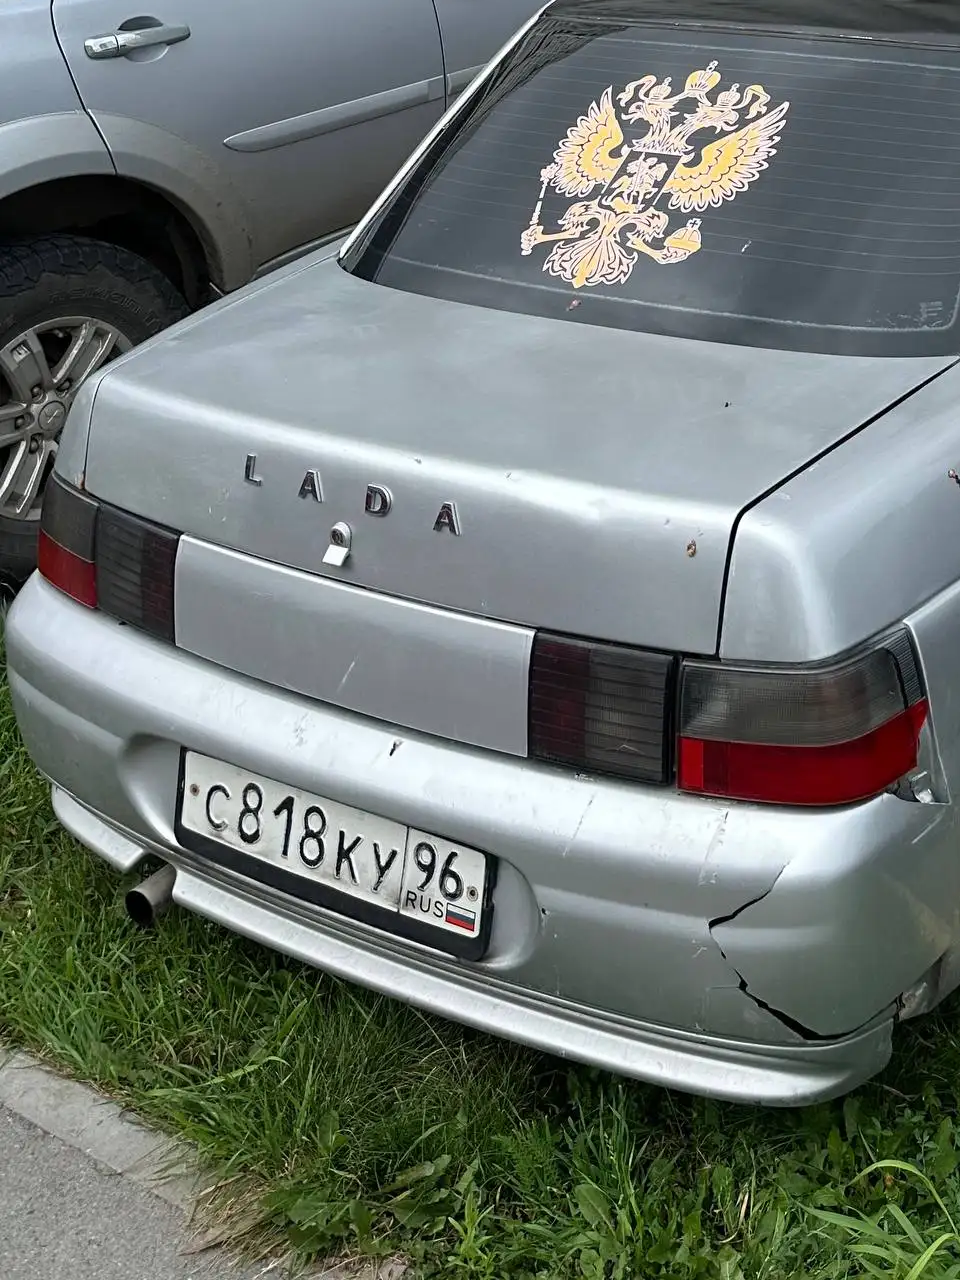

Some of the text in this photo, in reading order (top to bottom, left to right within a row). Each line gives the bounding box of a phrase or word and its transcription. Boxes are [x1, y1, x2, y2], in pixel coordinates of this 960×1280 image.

[244, 453, 462, 537] LADA
[205, 782, 467, 901] С818КУ 96
[405, 891, 444, 919] RUS
